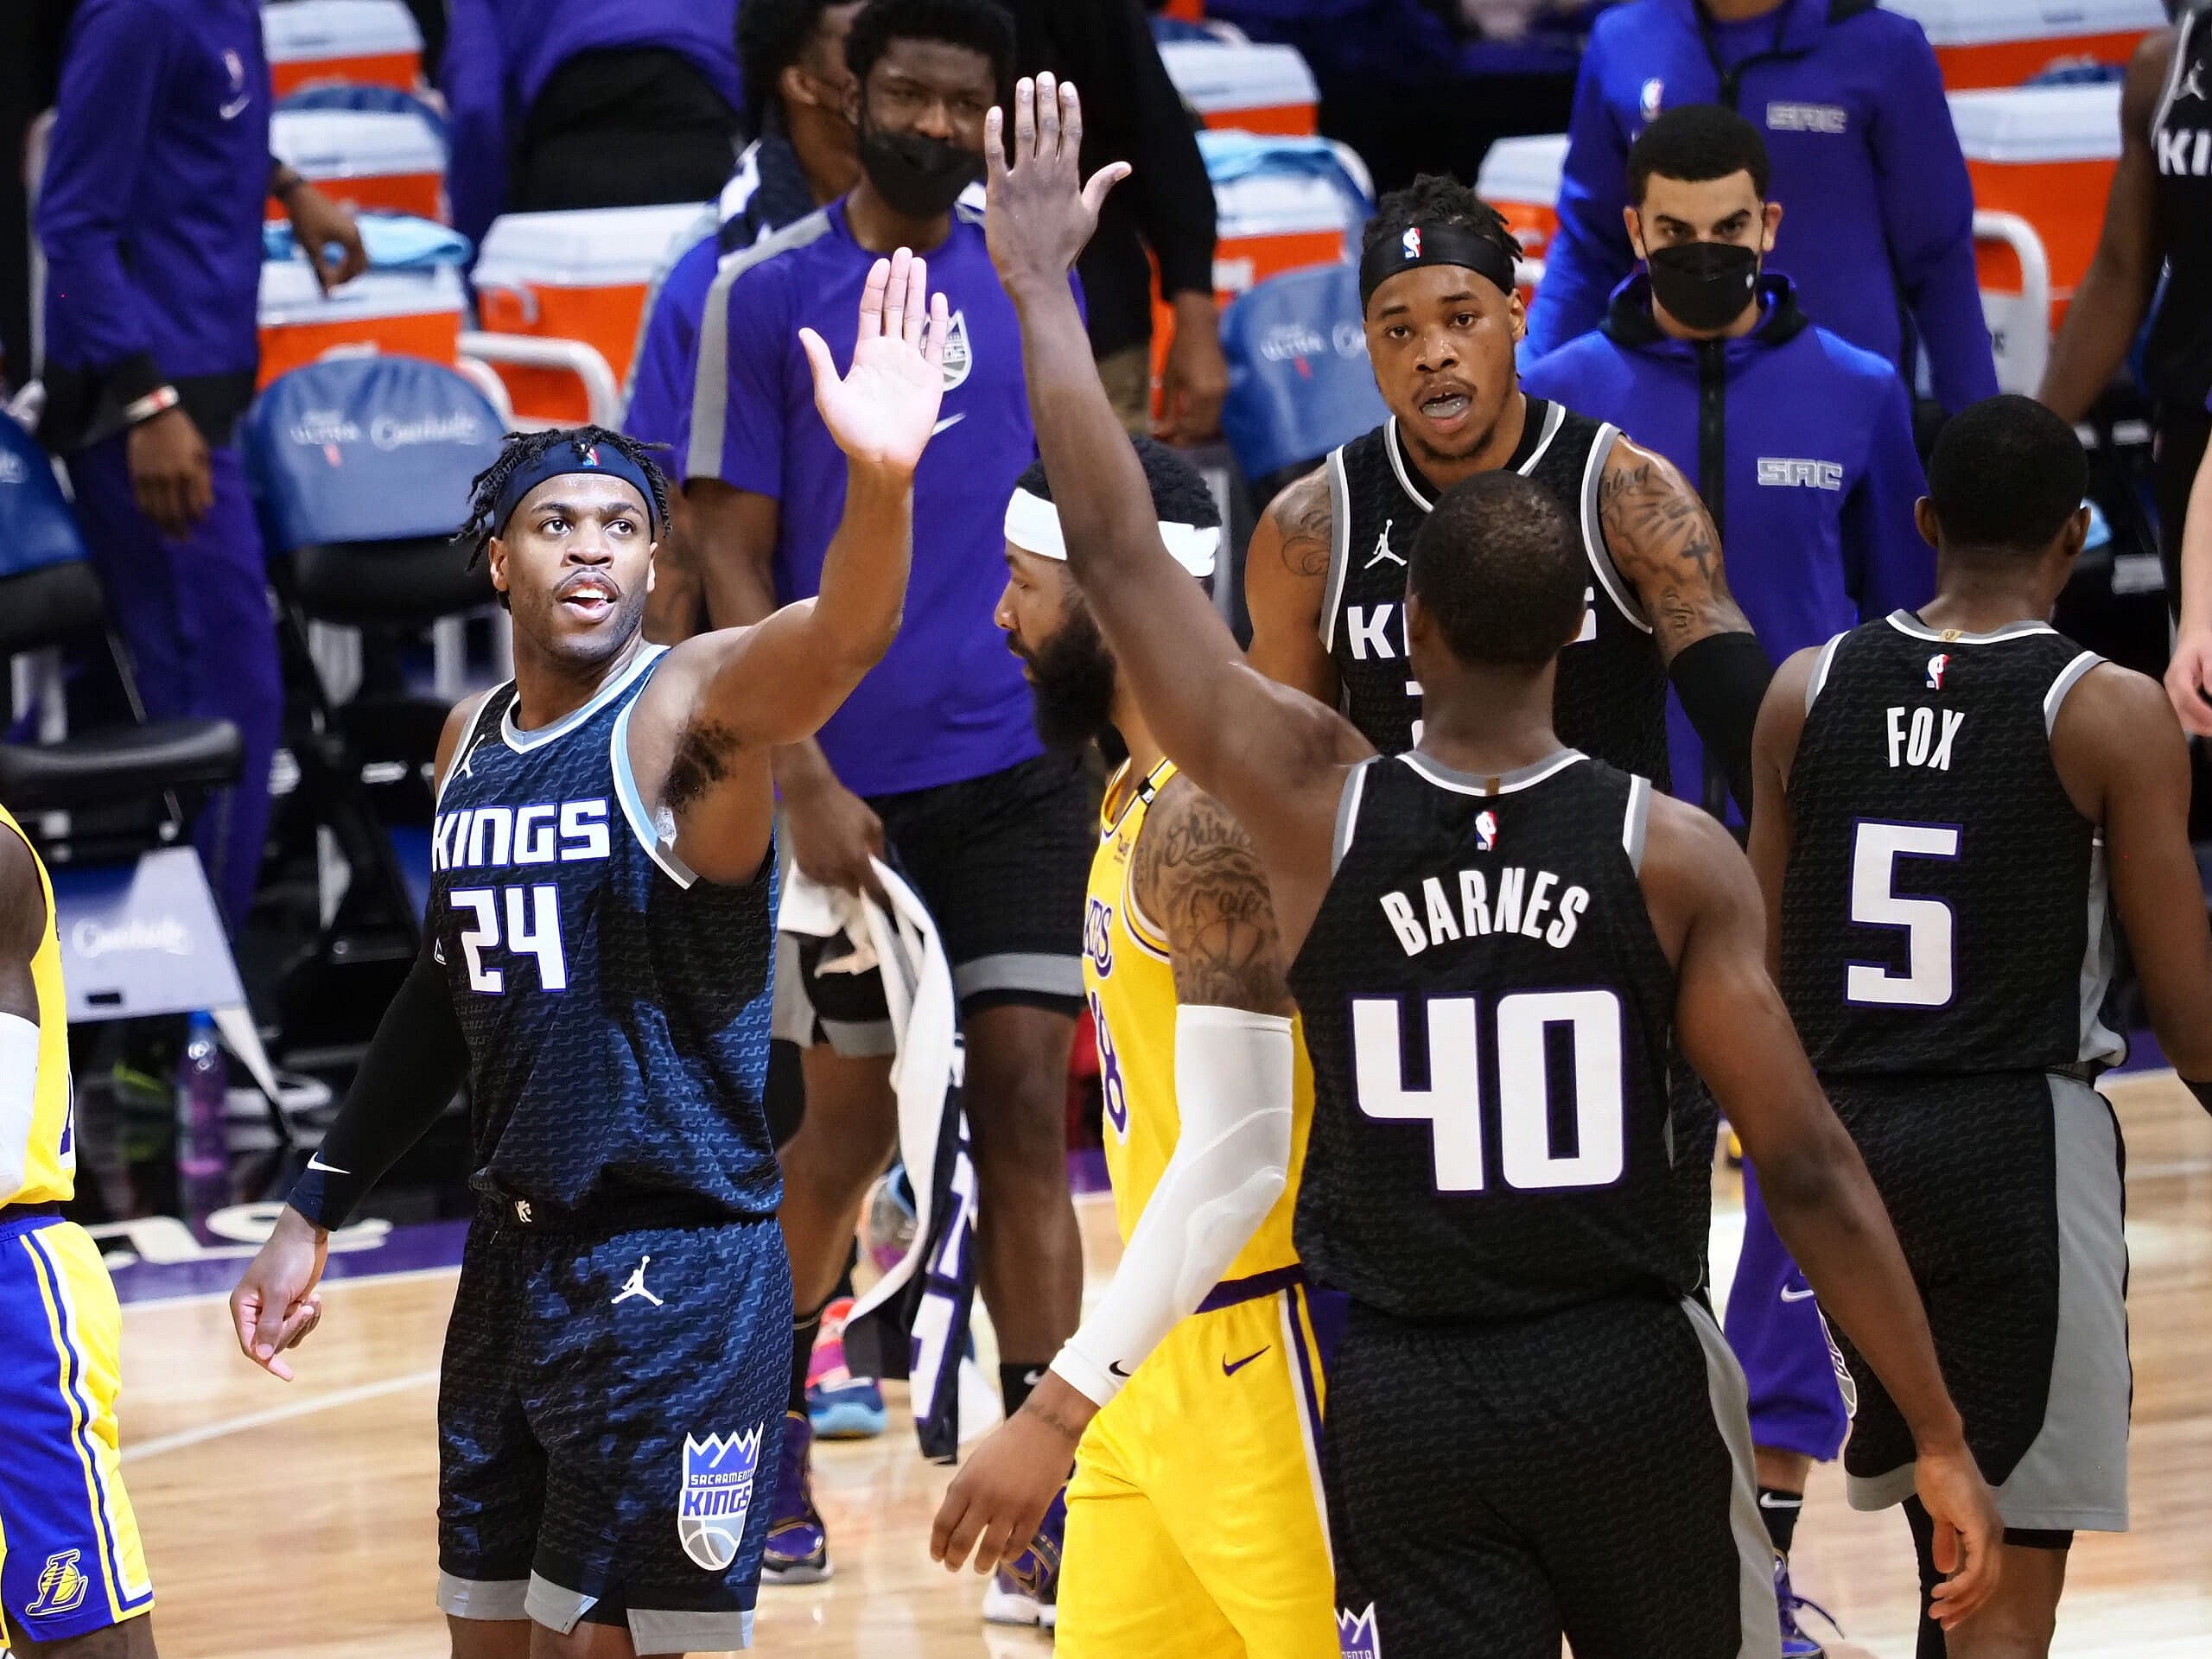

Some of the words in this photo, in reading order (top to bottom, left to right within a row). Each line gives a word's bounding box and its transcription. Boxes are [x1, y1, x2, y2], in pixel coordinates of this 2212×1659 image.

[1757, 456, 1843, 492] SAC
[1886, 706, 1966, 771] FOX
[432, 797, 611, 873] KINGS
[449, 883, 569, 995] 24
[1379, 867, 1590, 957] BARNES
[1847, 821, 1960, 1007] 5
[1351, 990, 1624, 1193] 40
[683, 1484, 752, 1516] KINGS
